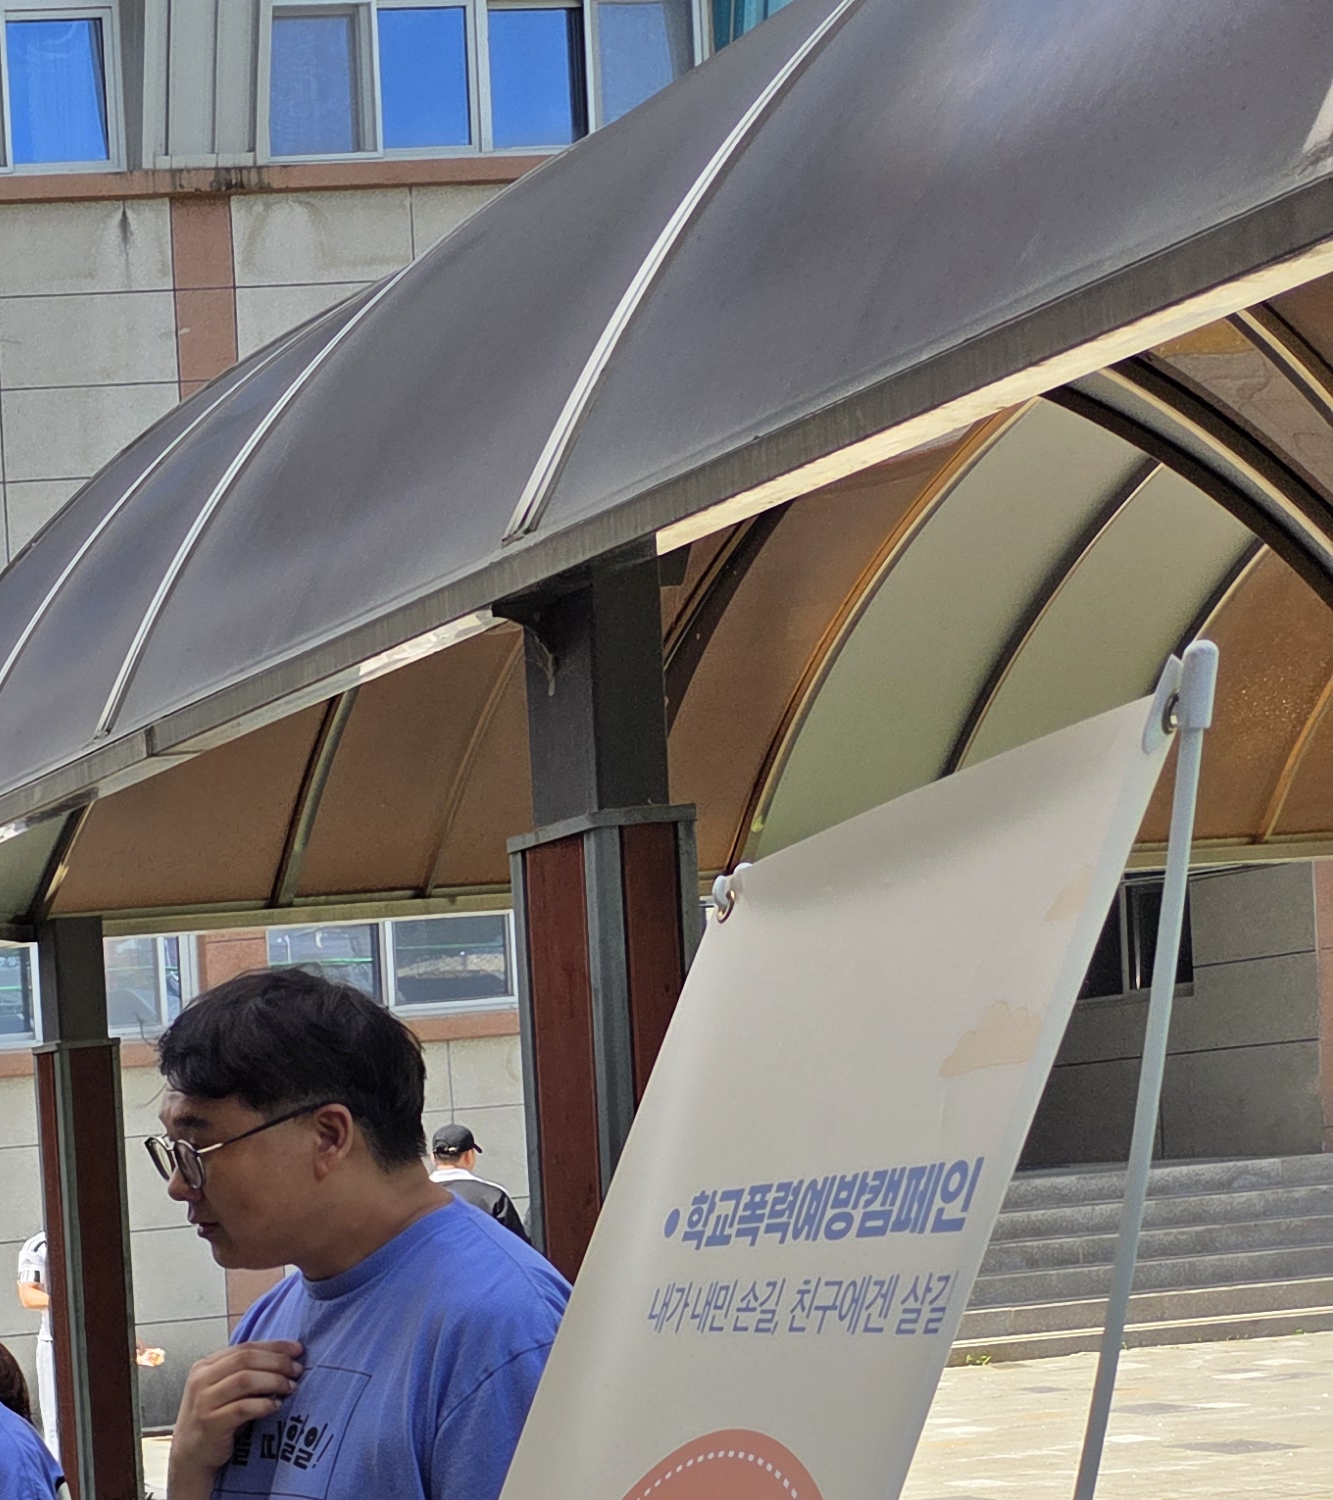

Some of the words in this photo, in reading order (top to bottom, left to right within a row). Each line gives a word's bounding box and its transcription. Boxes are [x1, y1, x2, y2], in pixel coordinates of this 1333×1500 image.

[681, 1157, 985, 1250] 학교폭력예방캠페인
[647, 1281, 693, 1334] 내가
[690, 1279, 738, 1334] 내민
[788, 1273, 901, 1335] 친구에겐
[895, 1270, 959, 1335] 살길
